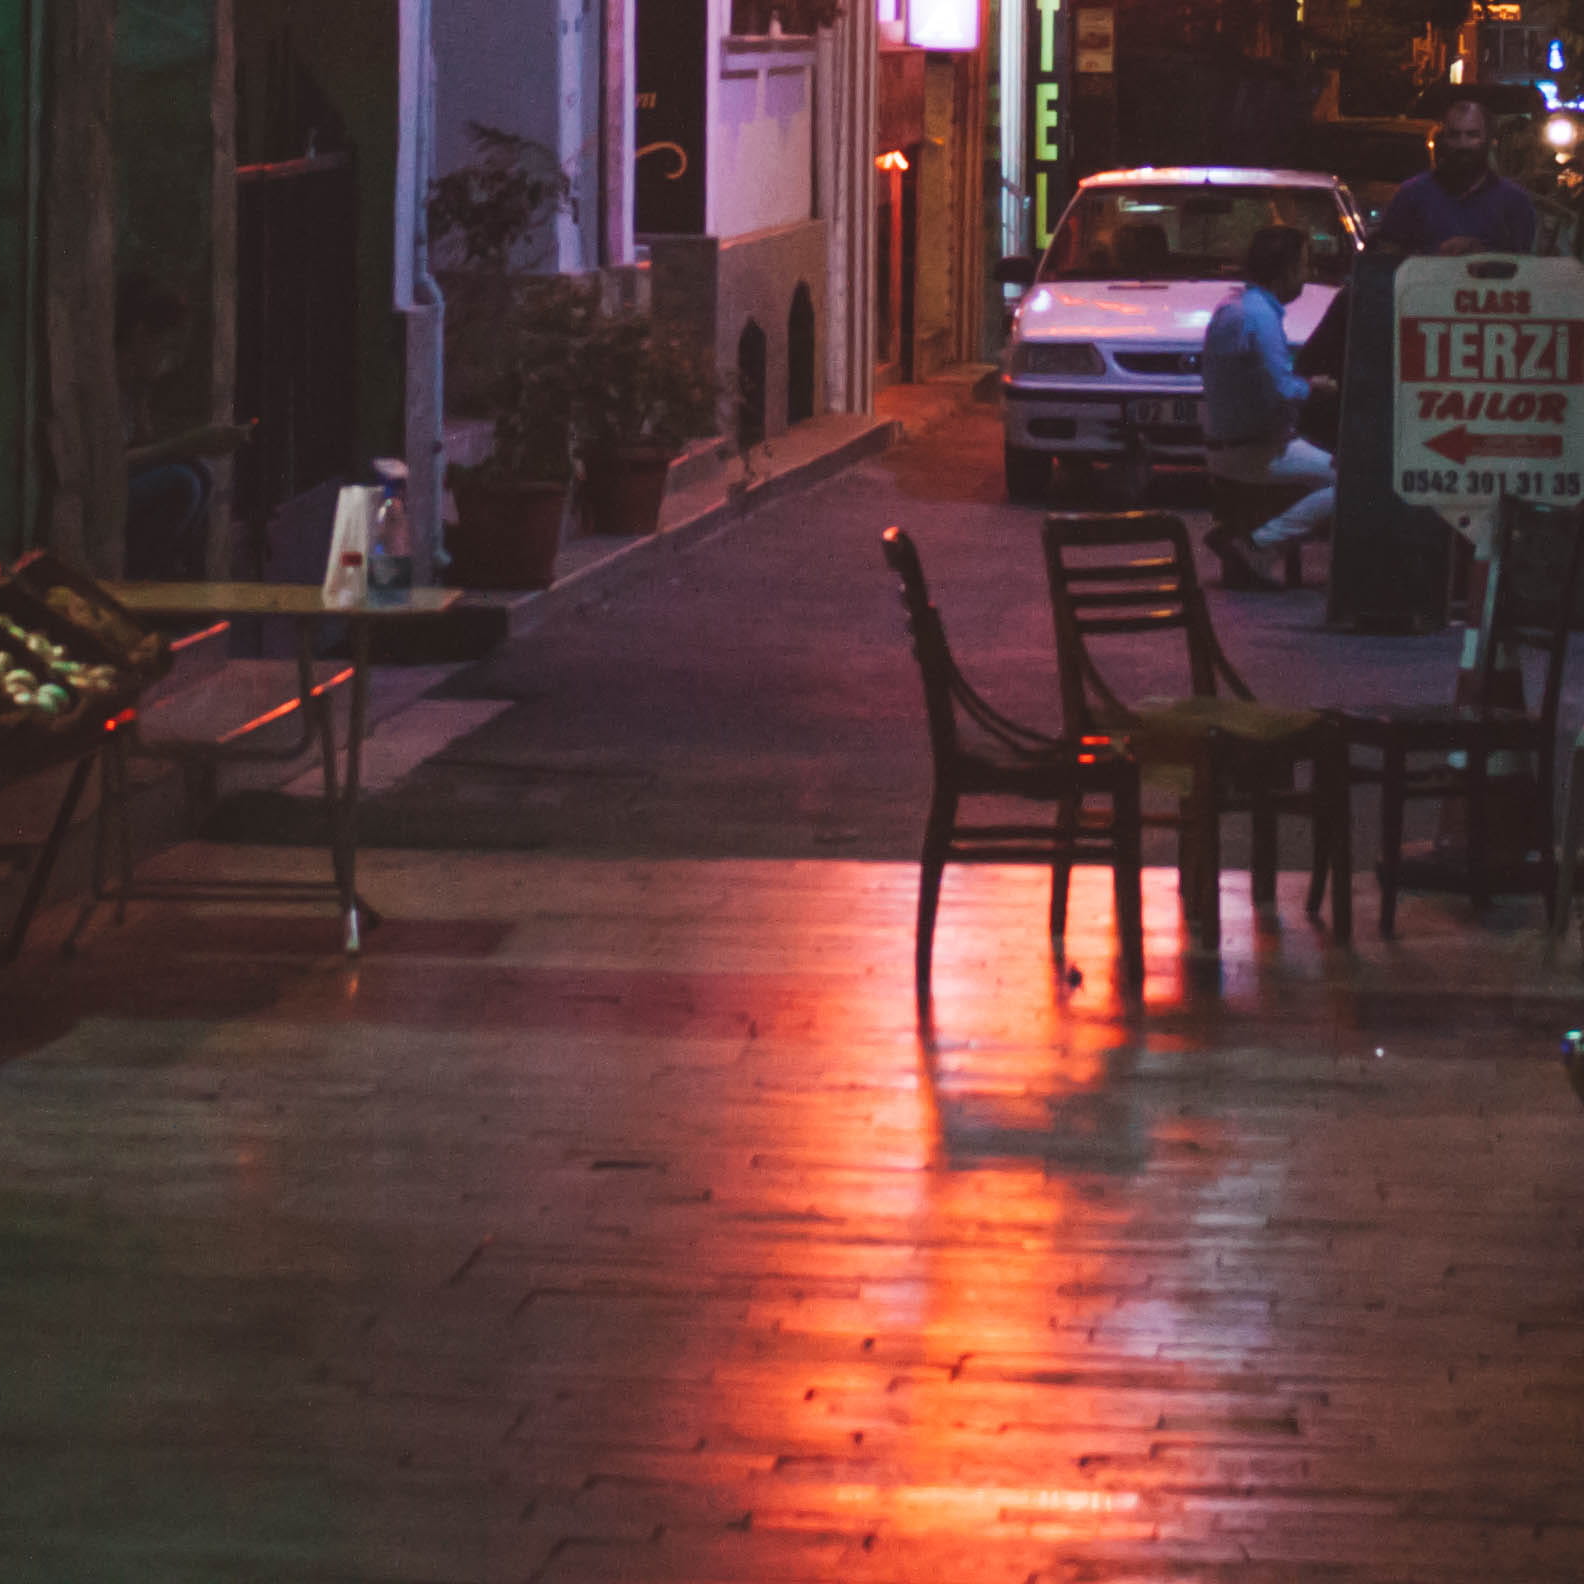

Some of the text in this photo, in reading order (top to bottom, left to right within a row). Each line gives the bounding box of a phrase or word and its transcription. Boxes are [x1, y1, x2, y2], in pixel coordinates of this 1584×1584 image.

[1454, 289, 1533, 315] CLASS
[1417, 390, 1568, 425] TAILOR
[1401, 469, 1459, 495] 0542
[1517, 470, 1543, 496] 31
[1553, 471, 1581, 497] 35
